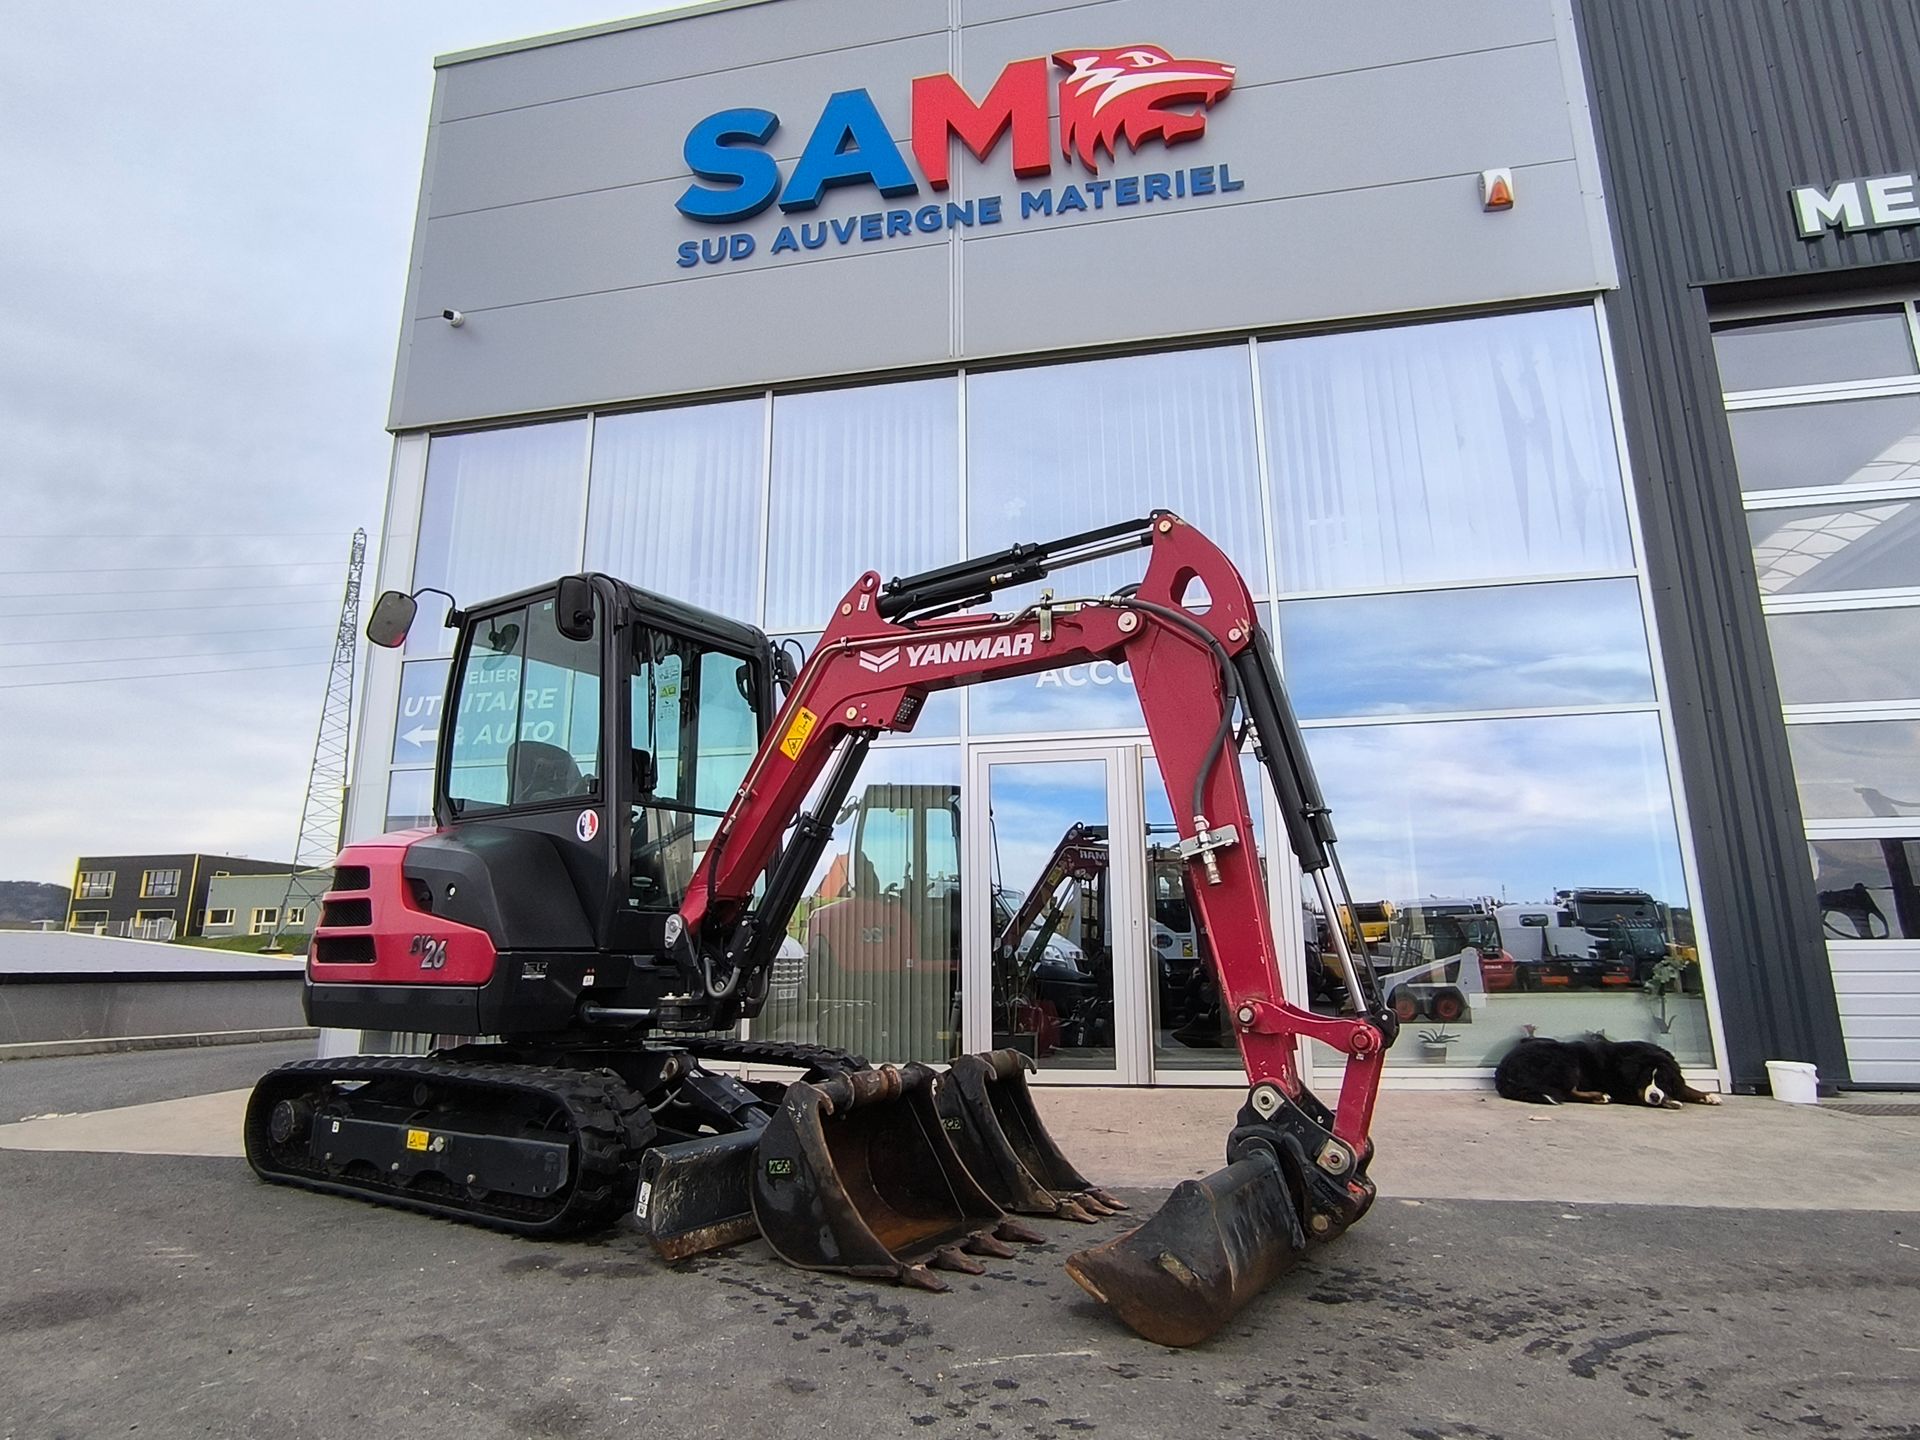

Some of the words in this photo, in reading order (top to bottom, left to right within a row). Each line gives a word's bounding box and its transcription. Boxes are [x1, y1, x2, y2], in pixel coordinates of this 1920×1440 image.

[675, 57, 1052, 223] SAM
[676, 234, 755, 267] SUD
[771, 197, 1001, 254] AUVERGNE
[1021, 164, 1244, 219] MATERIEL
[1795, 175, 1920, 234] ME
[906, 632, 1034, 667] YANMAR
[469, 669, 517, 684] ELIER
[404, 688, 557, 717] UTITAIRE
[472, 720, 554, 745] AUTO
